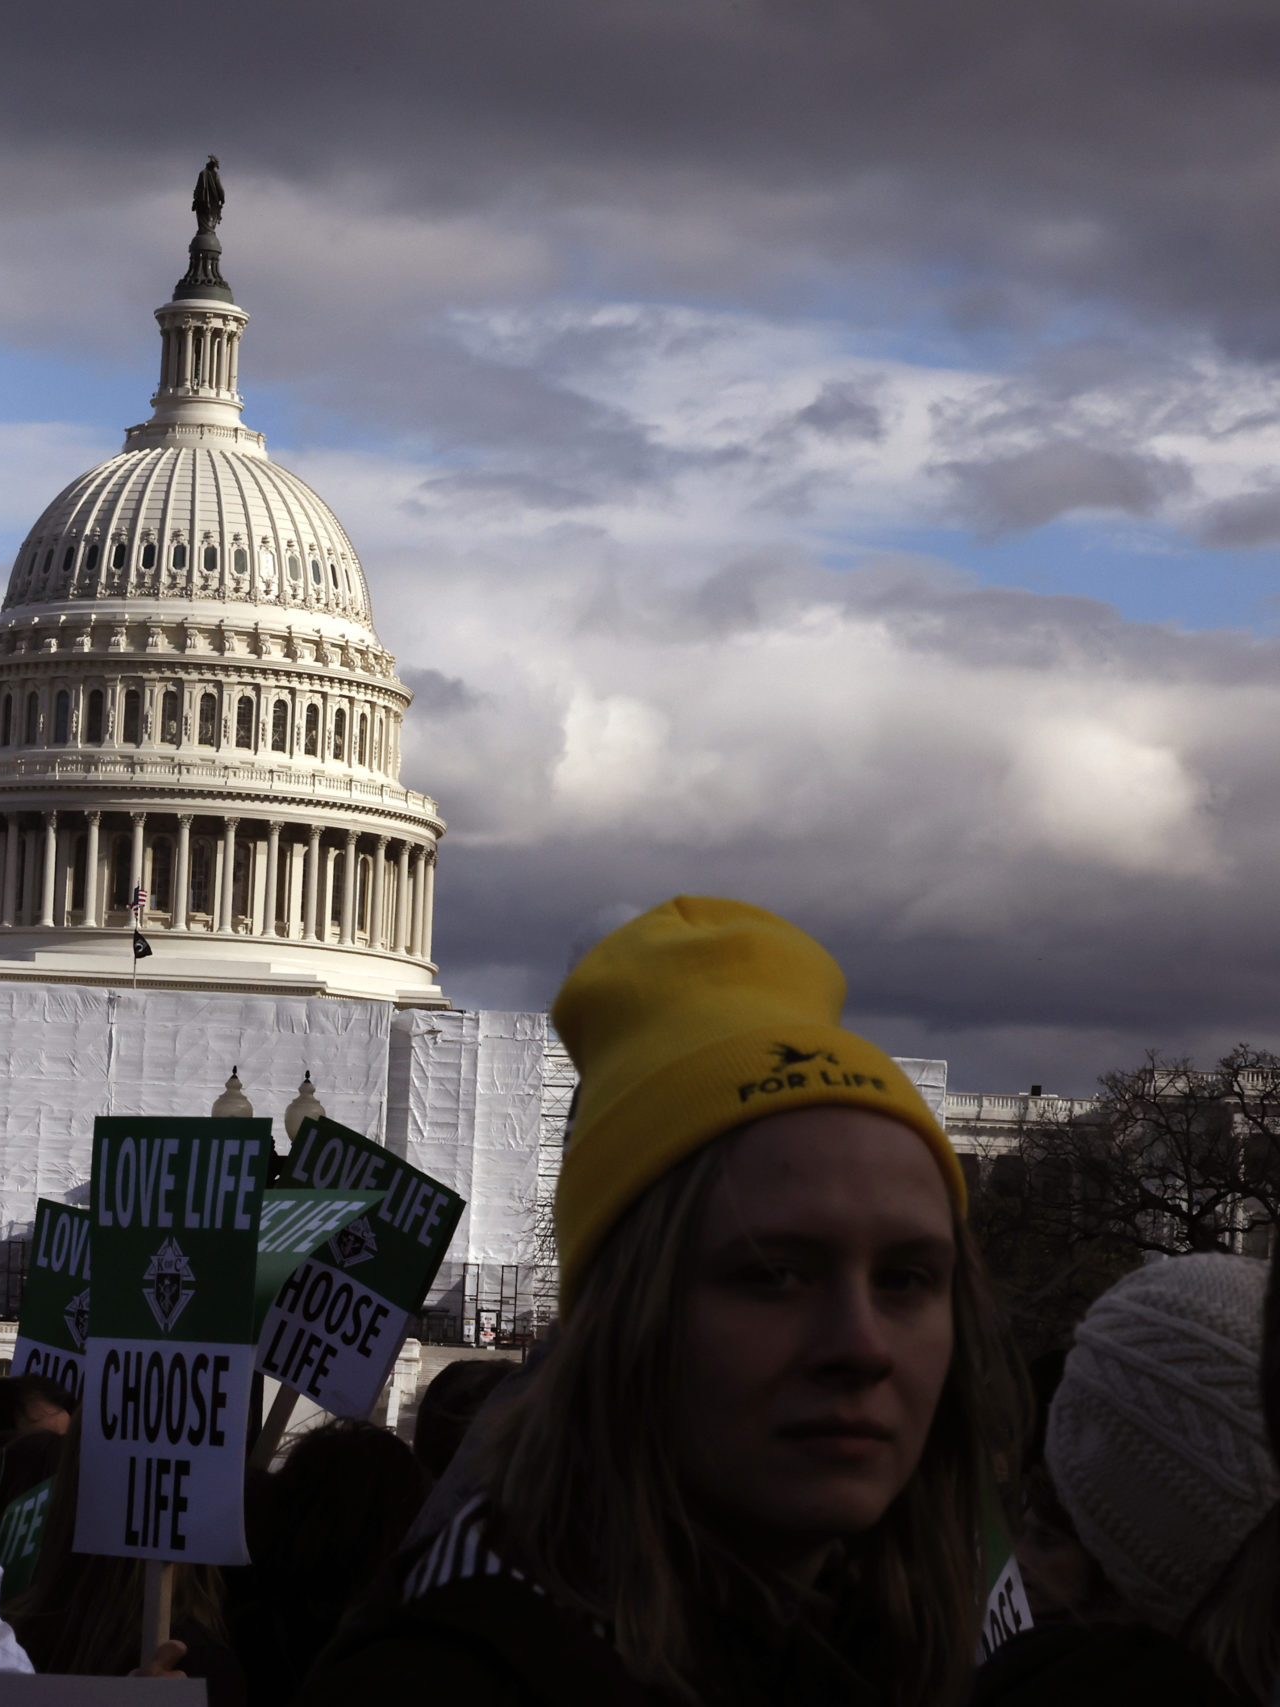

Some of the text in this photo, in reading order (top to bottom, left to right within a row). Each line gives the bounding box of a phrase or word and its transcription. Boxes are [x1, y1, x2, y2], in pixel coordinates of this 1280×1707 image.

[738, 1070, 886, 1102] FOR LIFE
[98, 1136, 261, 1231] LOVE LIFE
[258, 1200, 367, 1252] LIFE
[377, 1168, 450, 1248] LIFE
[275, 1264, 390, 1359] HOOSE
[101, 1349, 230, 1447] CHOOSE
[262, 1320, 338, 1398] LIFE
[125, 1457, 190, 1551] LIFE
